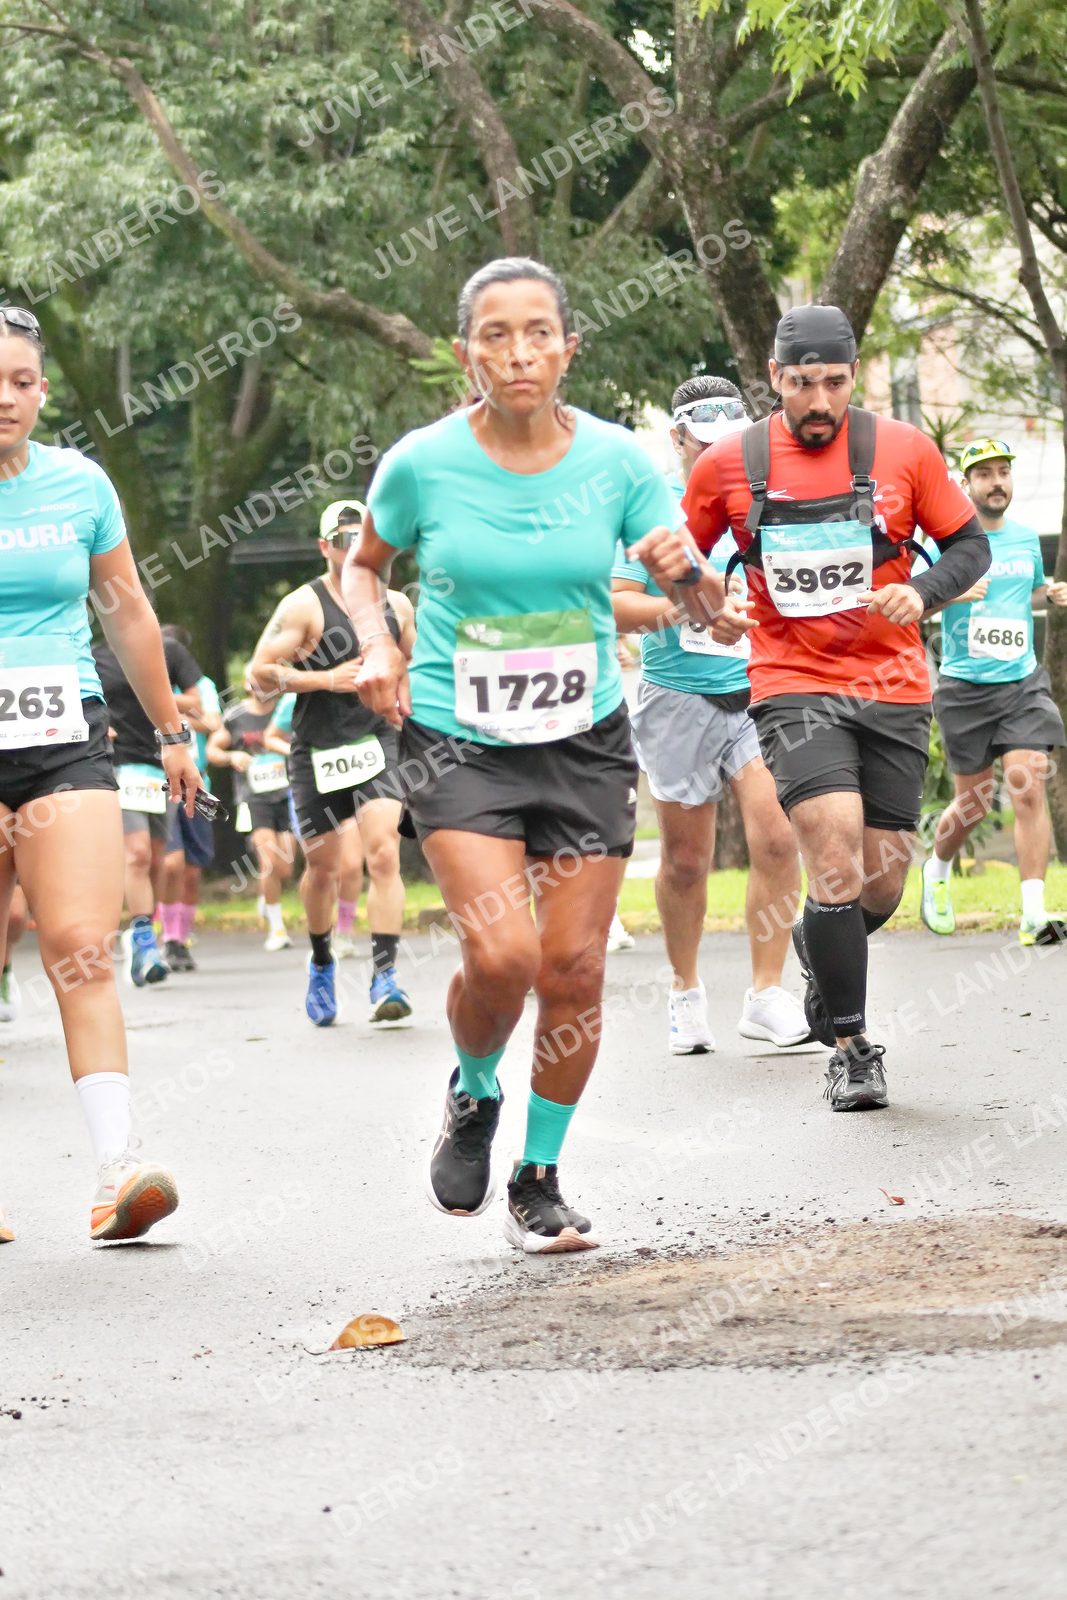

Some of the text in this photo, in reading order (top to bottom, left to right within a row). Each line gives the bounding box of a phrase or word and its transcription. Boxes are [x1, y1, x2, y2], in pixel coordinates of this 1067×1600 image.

[772, 561, 864, 593] 3962
[973, 628, 1024, 647] 4686
[0, 686, 65, 720] 263
[469, 669, 586, 713] 1728
[321, 751, 377, 777] 2049
